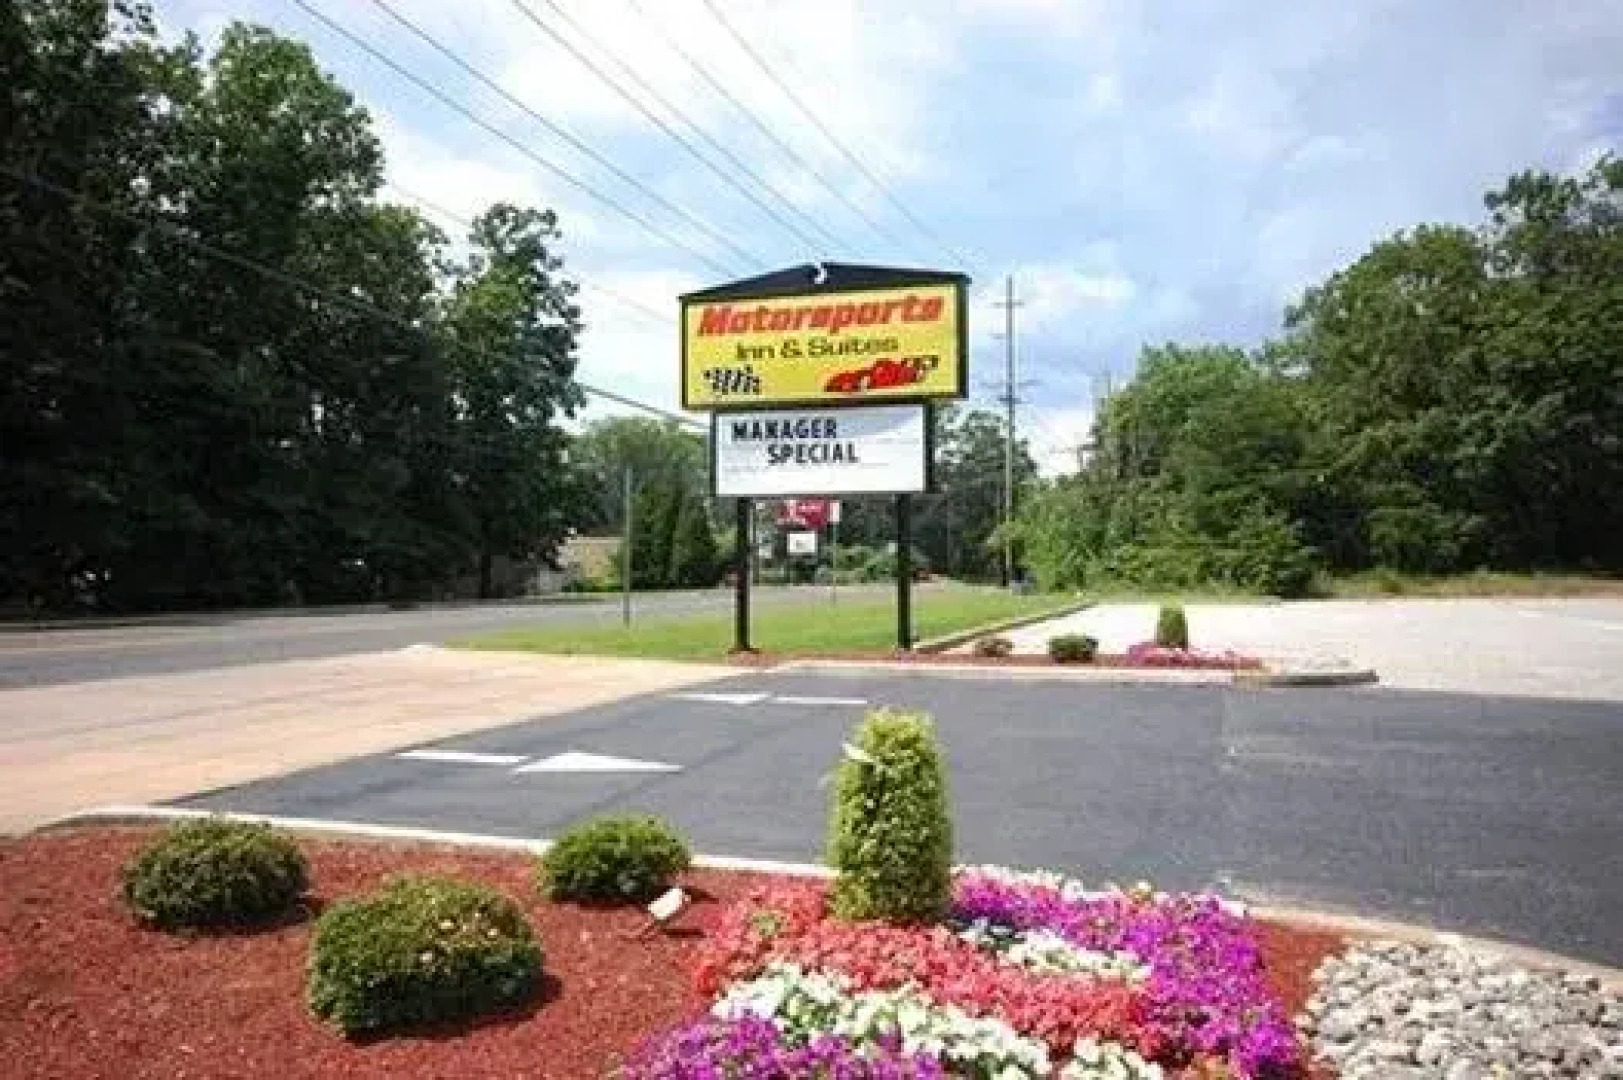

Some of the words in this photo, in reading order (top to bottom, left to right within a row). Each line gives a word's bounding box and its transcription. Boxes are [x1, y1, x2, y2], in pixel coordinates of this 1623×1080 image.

[697, 295, 944, 336] Motorsports
[737, 342, 775, 360] Inn
[781, 339, 803, 358] &
[808, 336, 898, 357] Suites
[732, 417, 837, 440] MANAGER
[768, 443, 859, 464] SPECIAL
